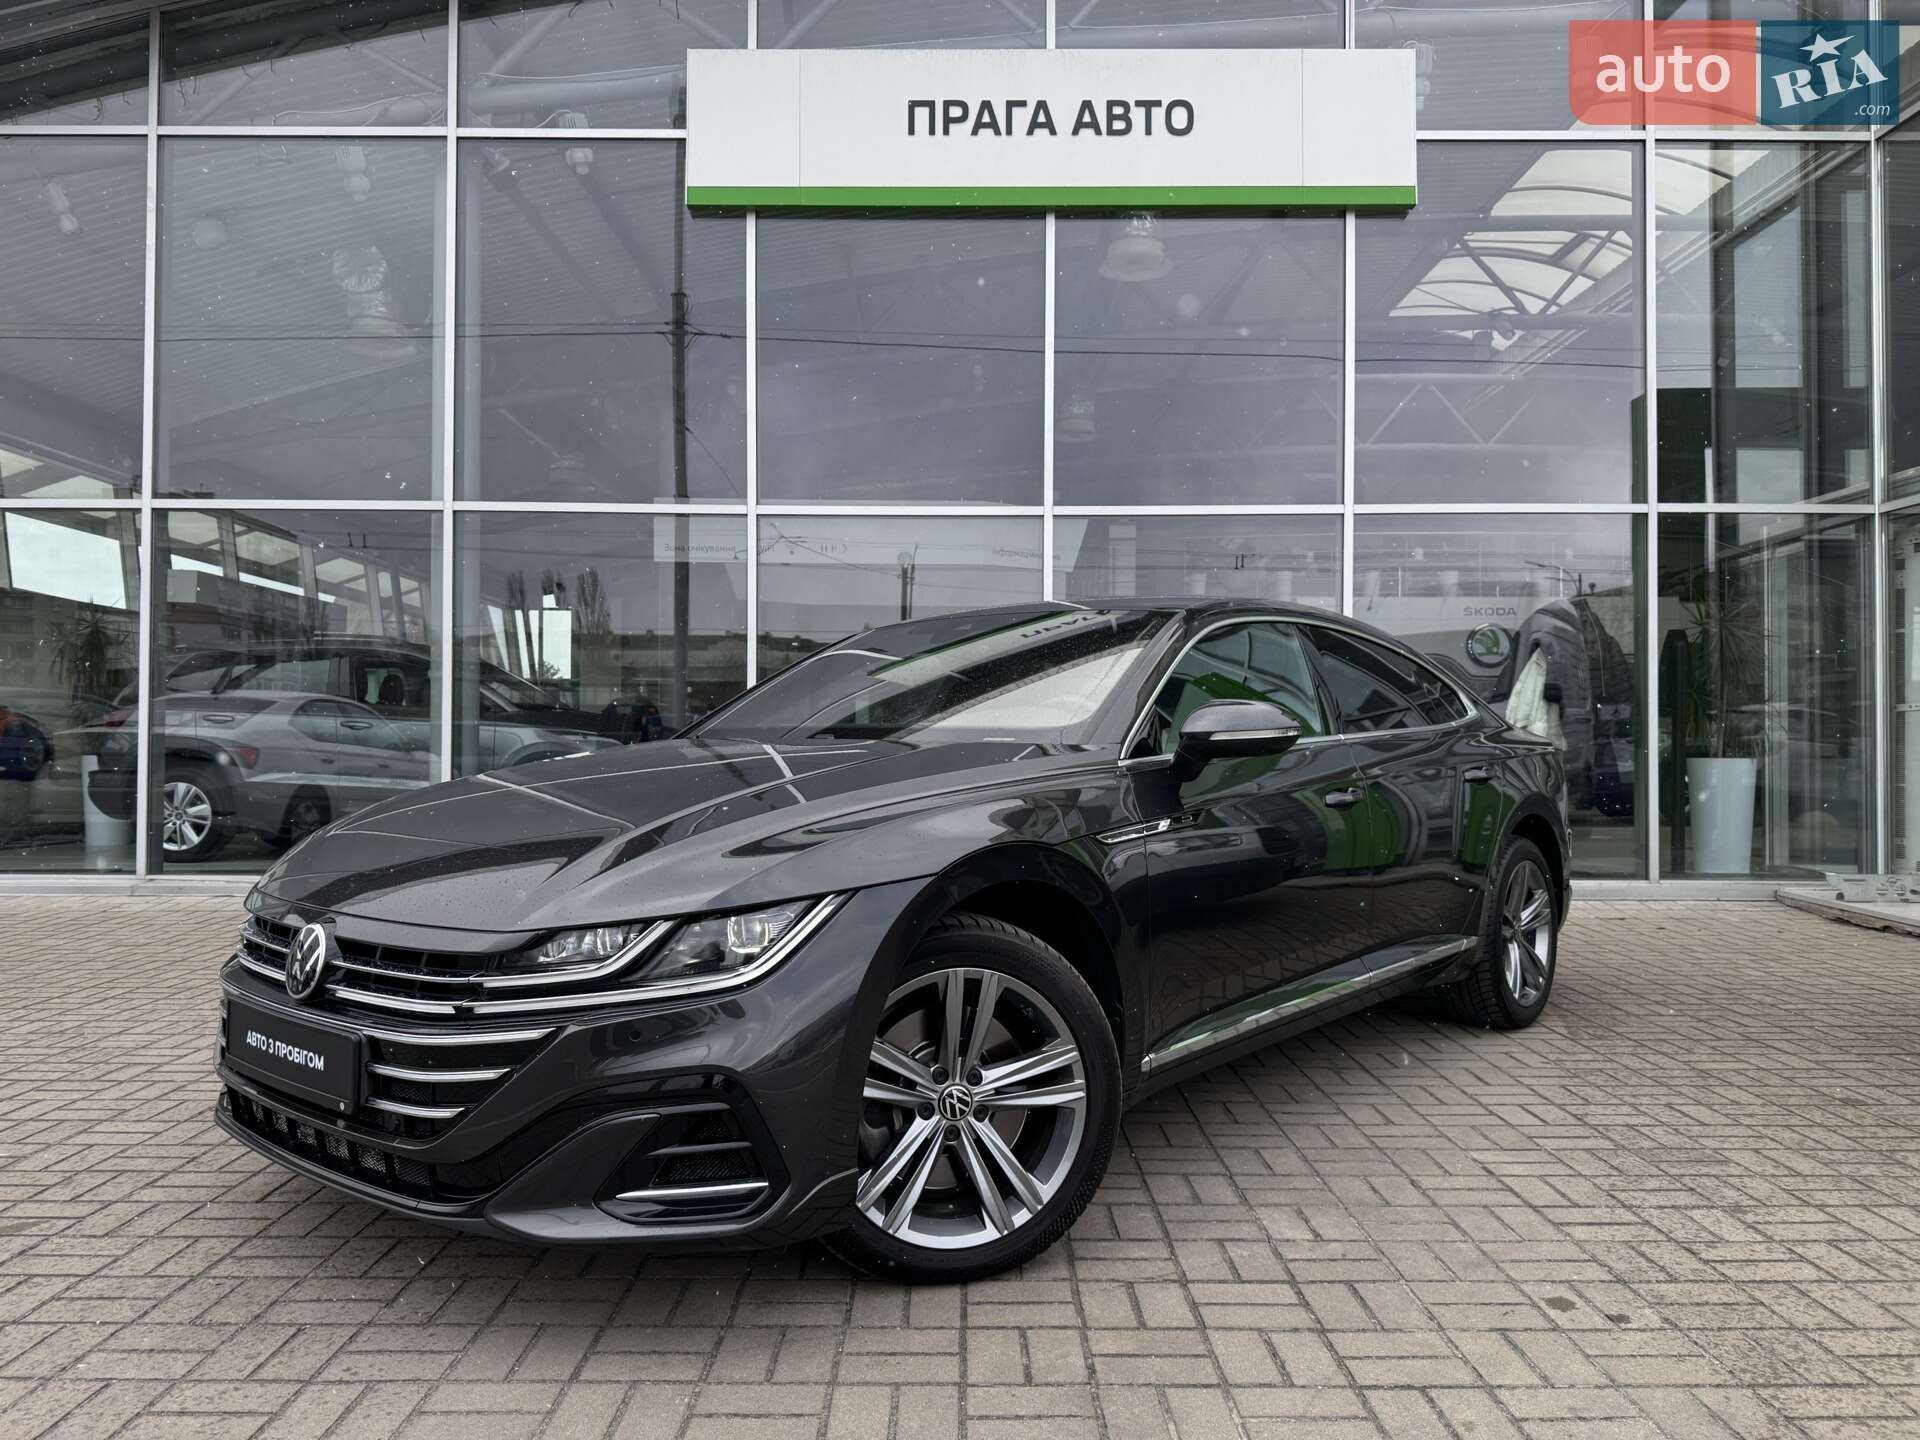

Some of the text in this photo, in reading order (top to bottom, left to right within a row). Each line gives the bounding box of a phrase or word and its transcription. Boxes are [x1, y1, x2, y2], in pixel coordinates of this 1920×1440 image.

[907, 98, 1195, 137] ПРАГА АВТО
[1463, 605, 1517, 617] ŠKODA
[246, 1029, 267, 1051] АВТО
[275, 1040, 324, 1072] ПРОБІГОМ
